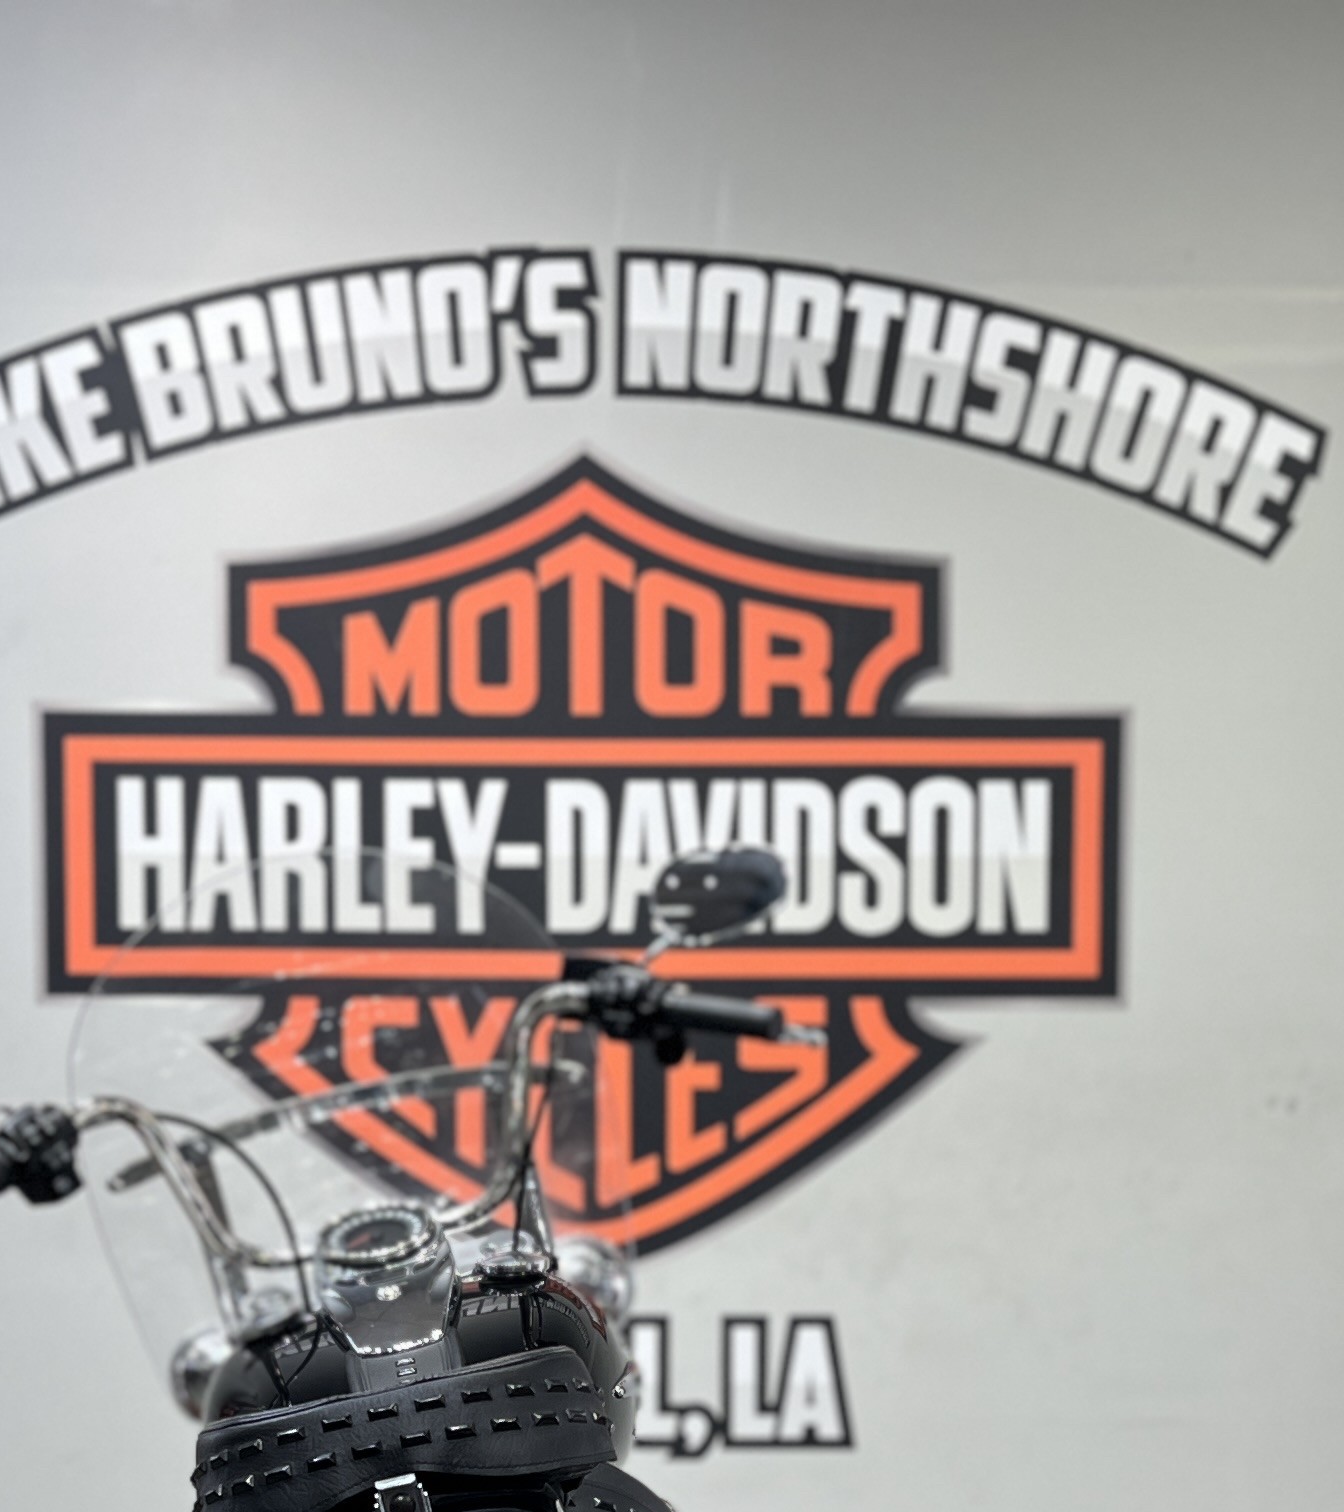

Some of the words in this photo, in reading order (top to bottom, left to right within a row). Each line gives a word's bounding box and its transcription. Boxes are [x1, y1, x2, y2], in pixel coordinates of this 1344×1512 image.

[108, 245, 601, 462] BRUNO'S
[616, 248, 1328, 561] NORTHSHORE
[342, 533, 833, 719] MOTOR
